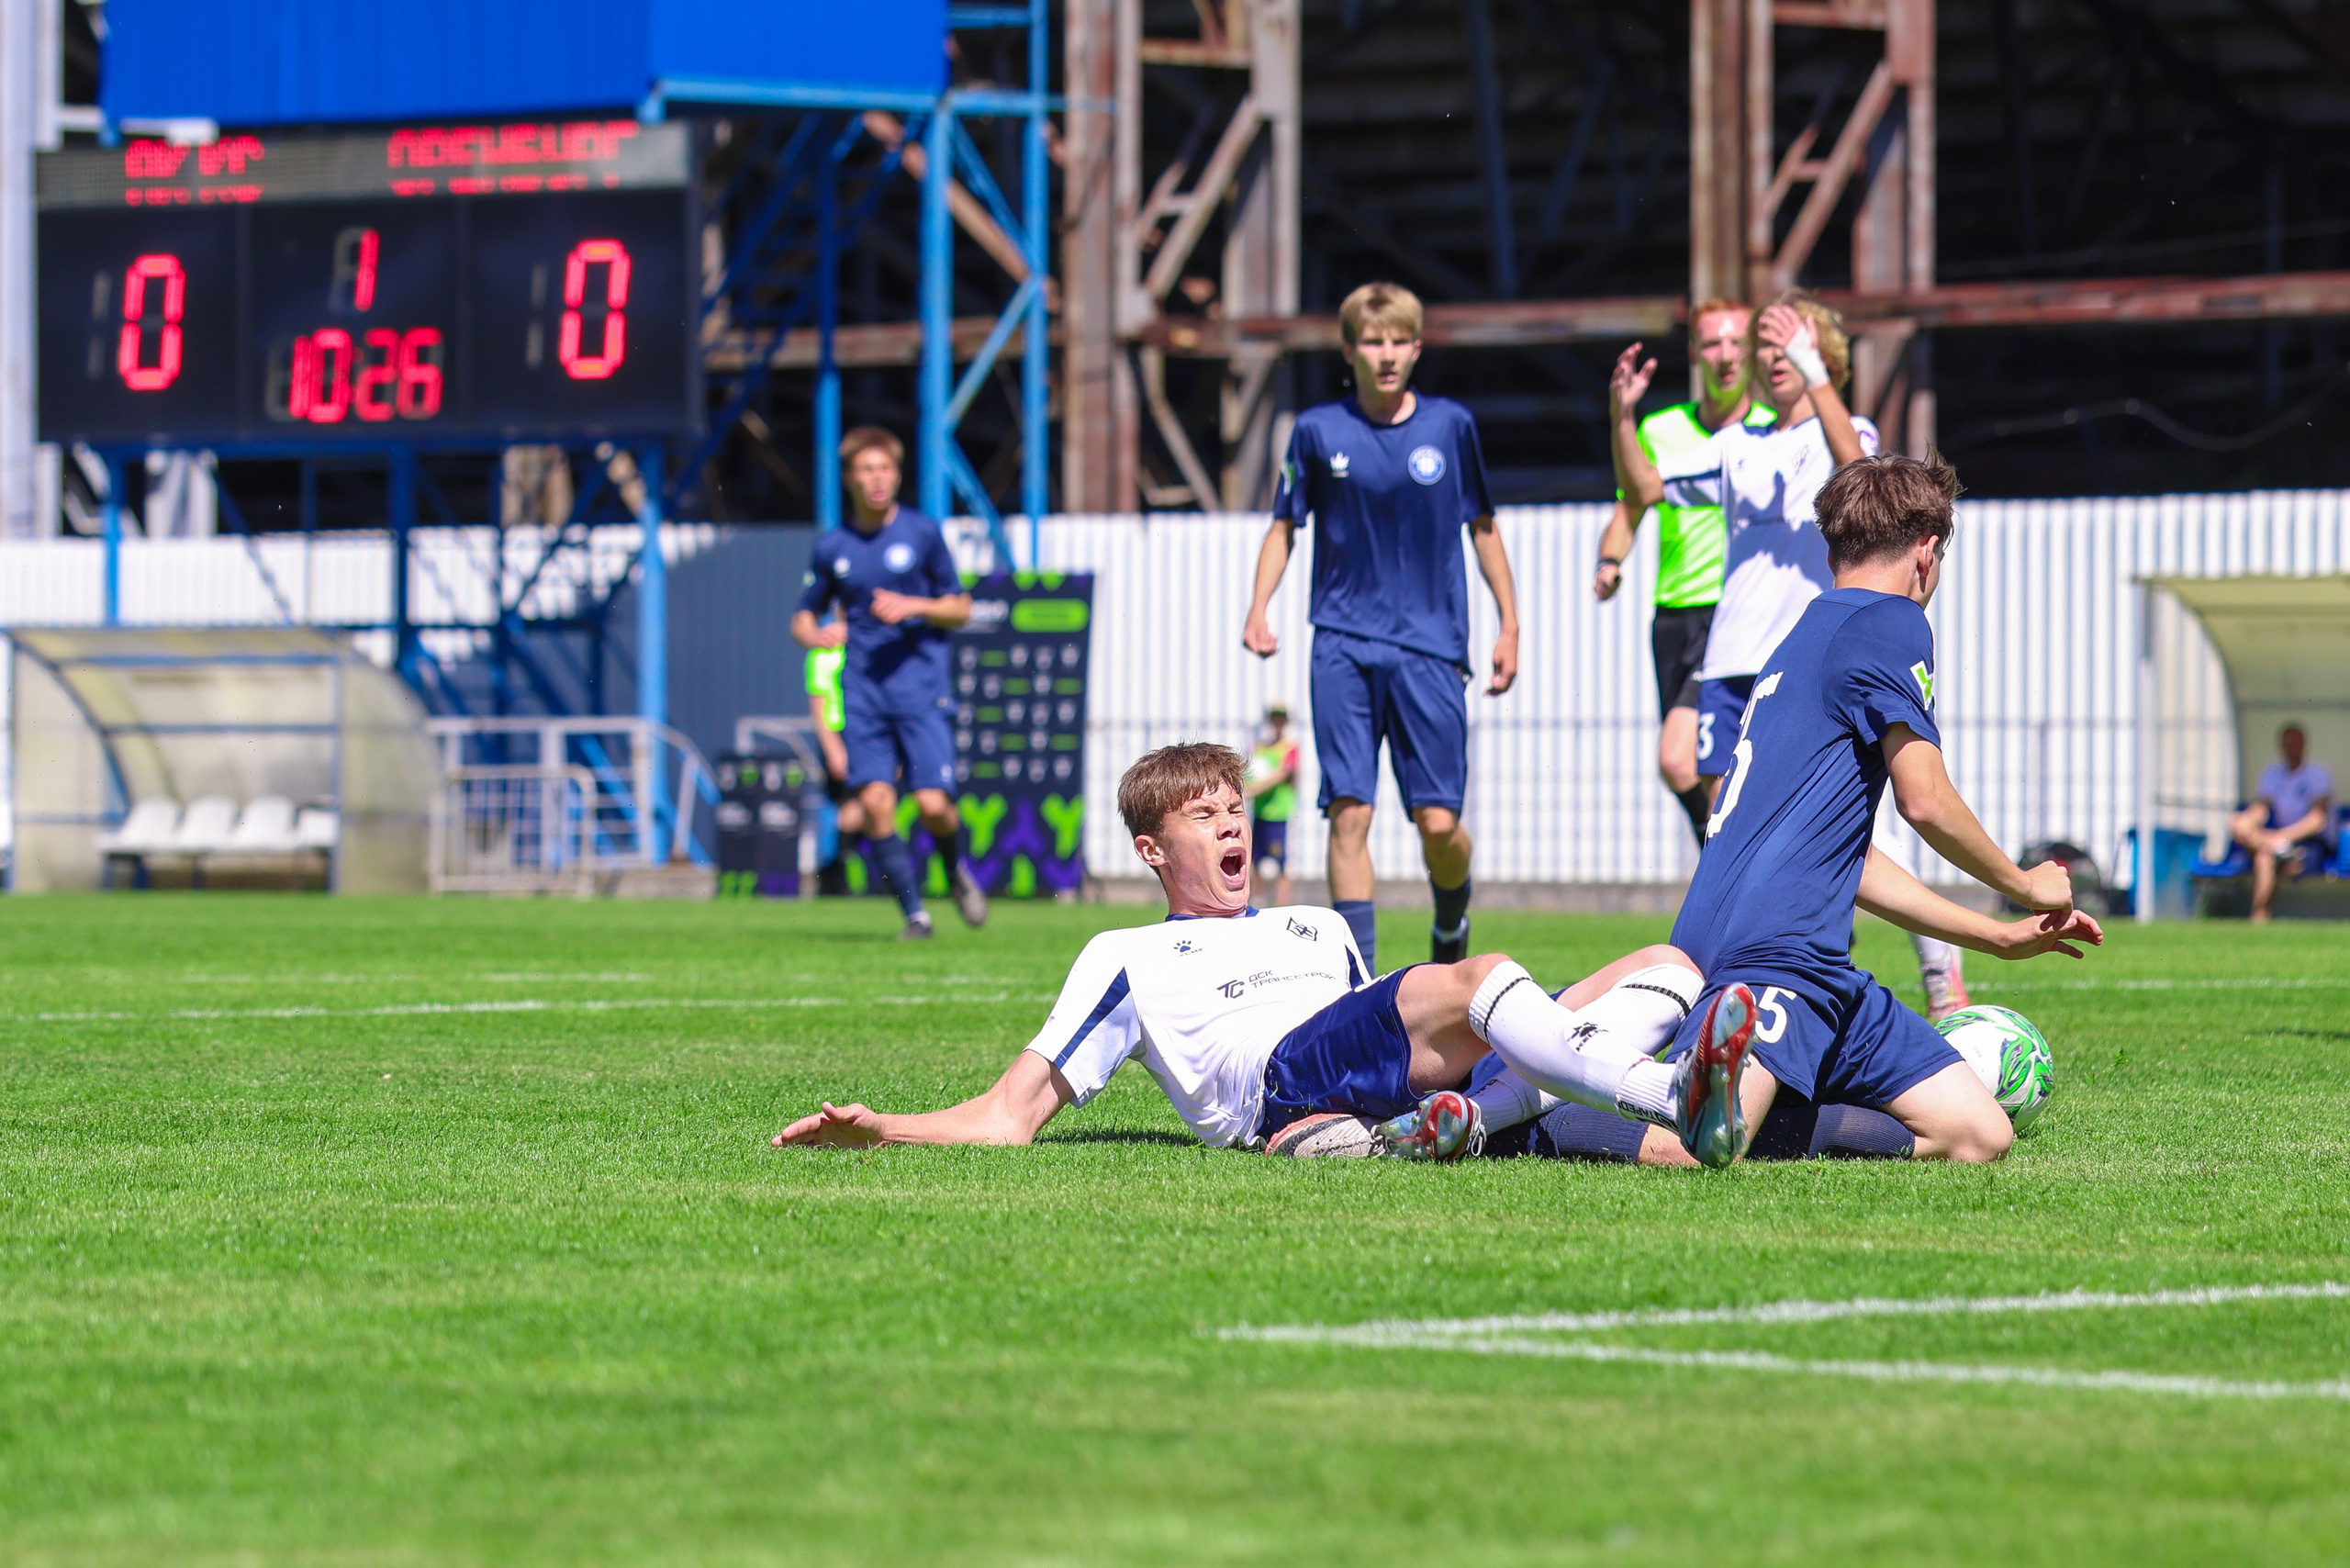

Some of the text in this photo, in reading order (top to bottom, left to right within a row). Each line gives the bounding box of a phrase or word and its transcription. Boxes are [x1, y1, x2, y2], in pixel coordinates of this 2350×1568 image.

[118, 254, 185, 390] 0
[355, 229, 379, 310] 1
[559, 241, 630, 379] 0
[1751, 986, 1797, 1044] 5
